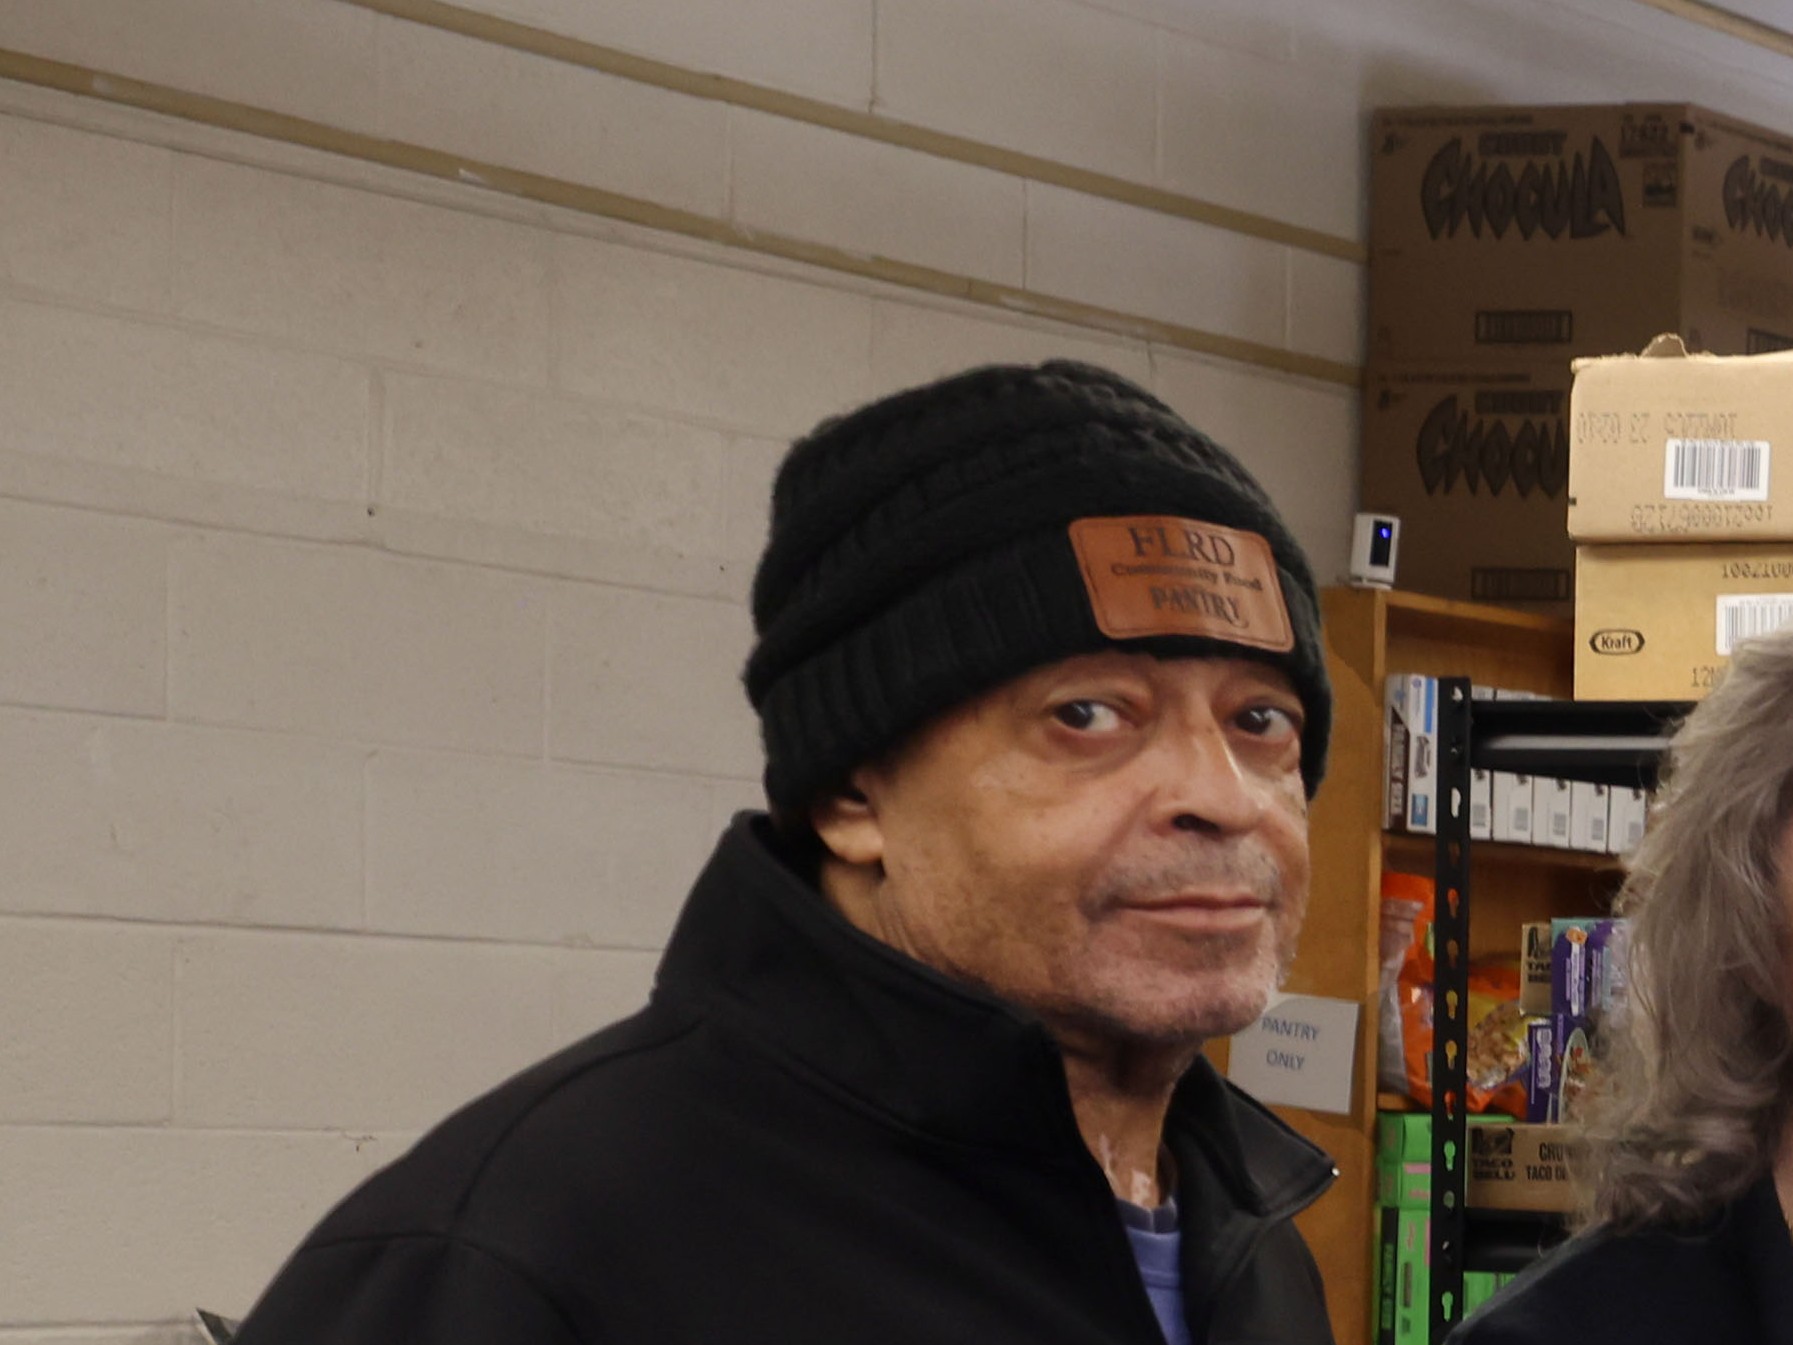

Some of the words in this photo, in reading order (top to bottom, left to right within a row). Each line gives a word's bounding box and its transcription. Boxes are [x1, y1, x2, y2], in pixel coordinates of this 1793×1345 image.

[1417, 394, 1568, 499] CHOCU
[1128, 527, 1235, 566] FLRD
[1149, 586, 1250, 629] PANTRY
[1599, 631, 1634, 651] Kraft
[1261, 1016, 1320, 1041] PANTRY
[1266, 1050, 1304, 1071] ONLY
